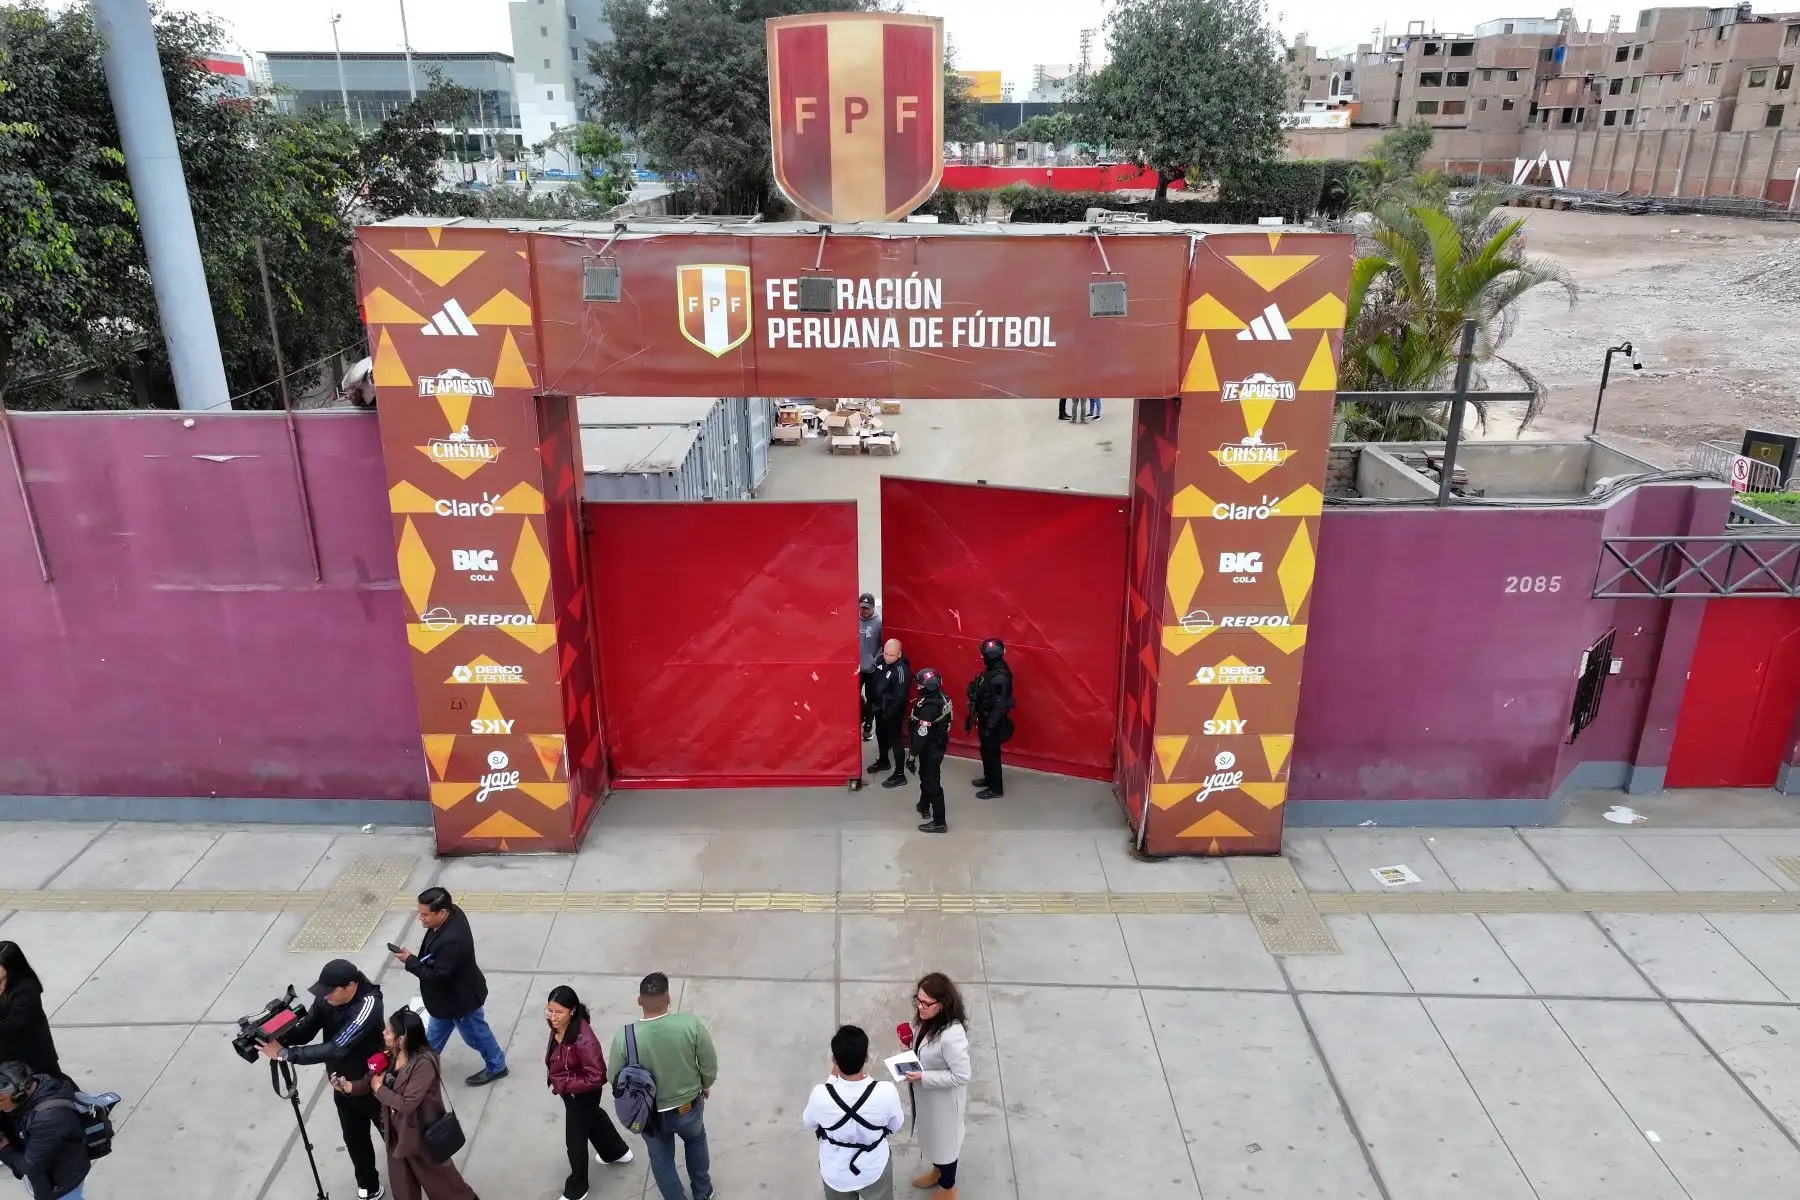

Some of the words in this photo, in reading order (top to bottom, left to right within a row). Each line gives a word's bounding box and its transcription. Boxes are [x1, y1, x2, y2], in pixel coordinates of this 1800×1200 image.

[766, 271, 942, 310] FERACIÓN
[767, 316, 901, 349] PERUANA
[909, 317, 943, 348] DE
[952, 310, 1057, 348] FÚTBOL
[420, 378, 435, 395] TE
[437, 379, 493, 396] APUESTO
[1223, 383, 1239, 399] TE
[1239, 382, 1294, 400] APUESTO
[432, 442, 494, 458] CRISTAL
[1222, 446, 1282, 462] CRISTAL
[434, 499, 496, 517] Claro
[1212, 503, 1271, 520] Claro
[452, 549, 498, 572] BIG
[1219, 552, 1263, 573] BIG
[1504, 575, 1562, 593] 2085
[464, 614, 536, 626] REPSOL
[1220, 615, 1290, 627] REPSOL
[475, 665, 523, 674] DERCO
[1219, 666, 1266, 675] DERCO
[470, 719, 515, 735] SKY
[1203, 719, 1248, 735] SKY
[475, 770, 520, 803] yape
[1195, 770, 1244, 803] yape
